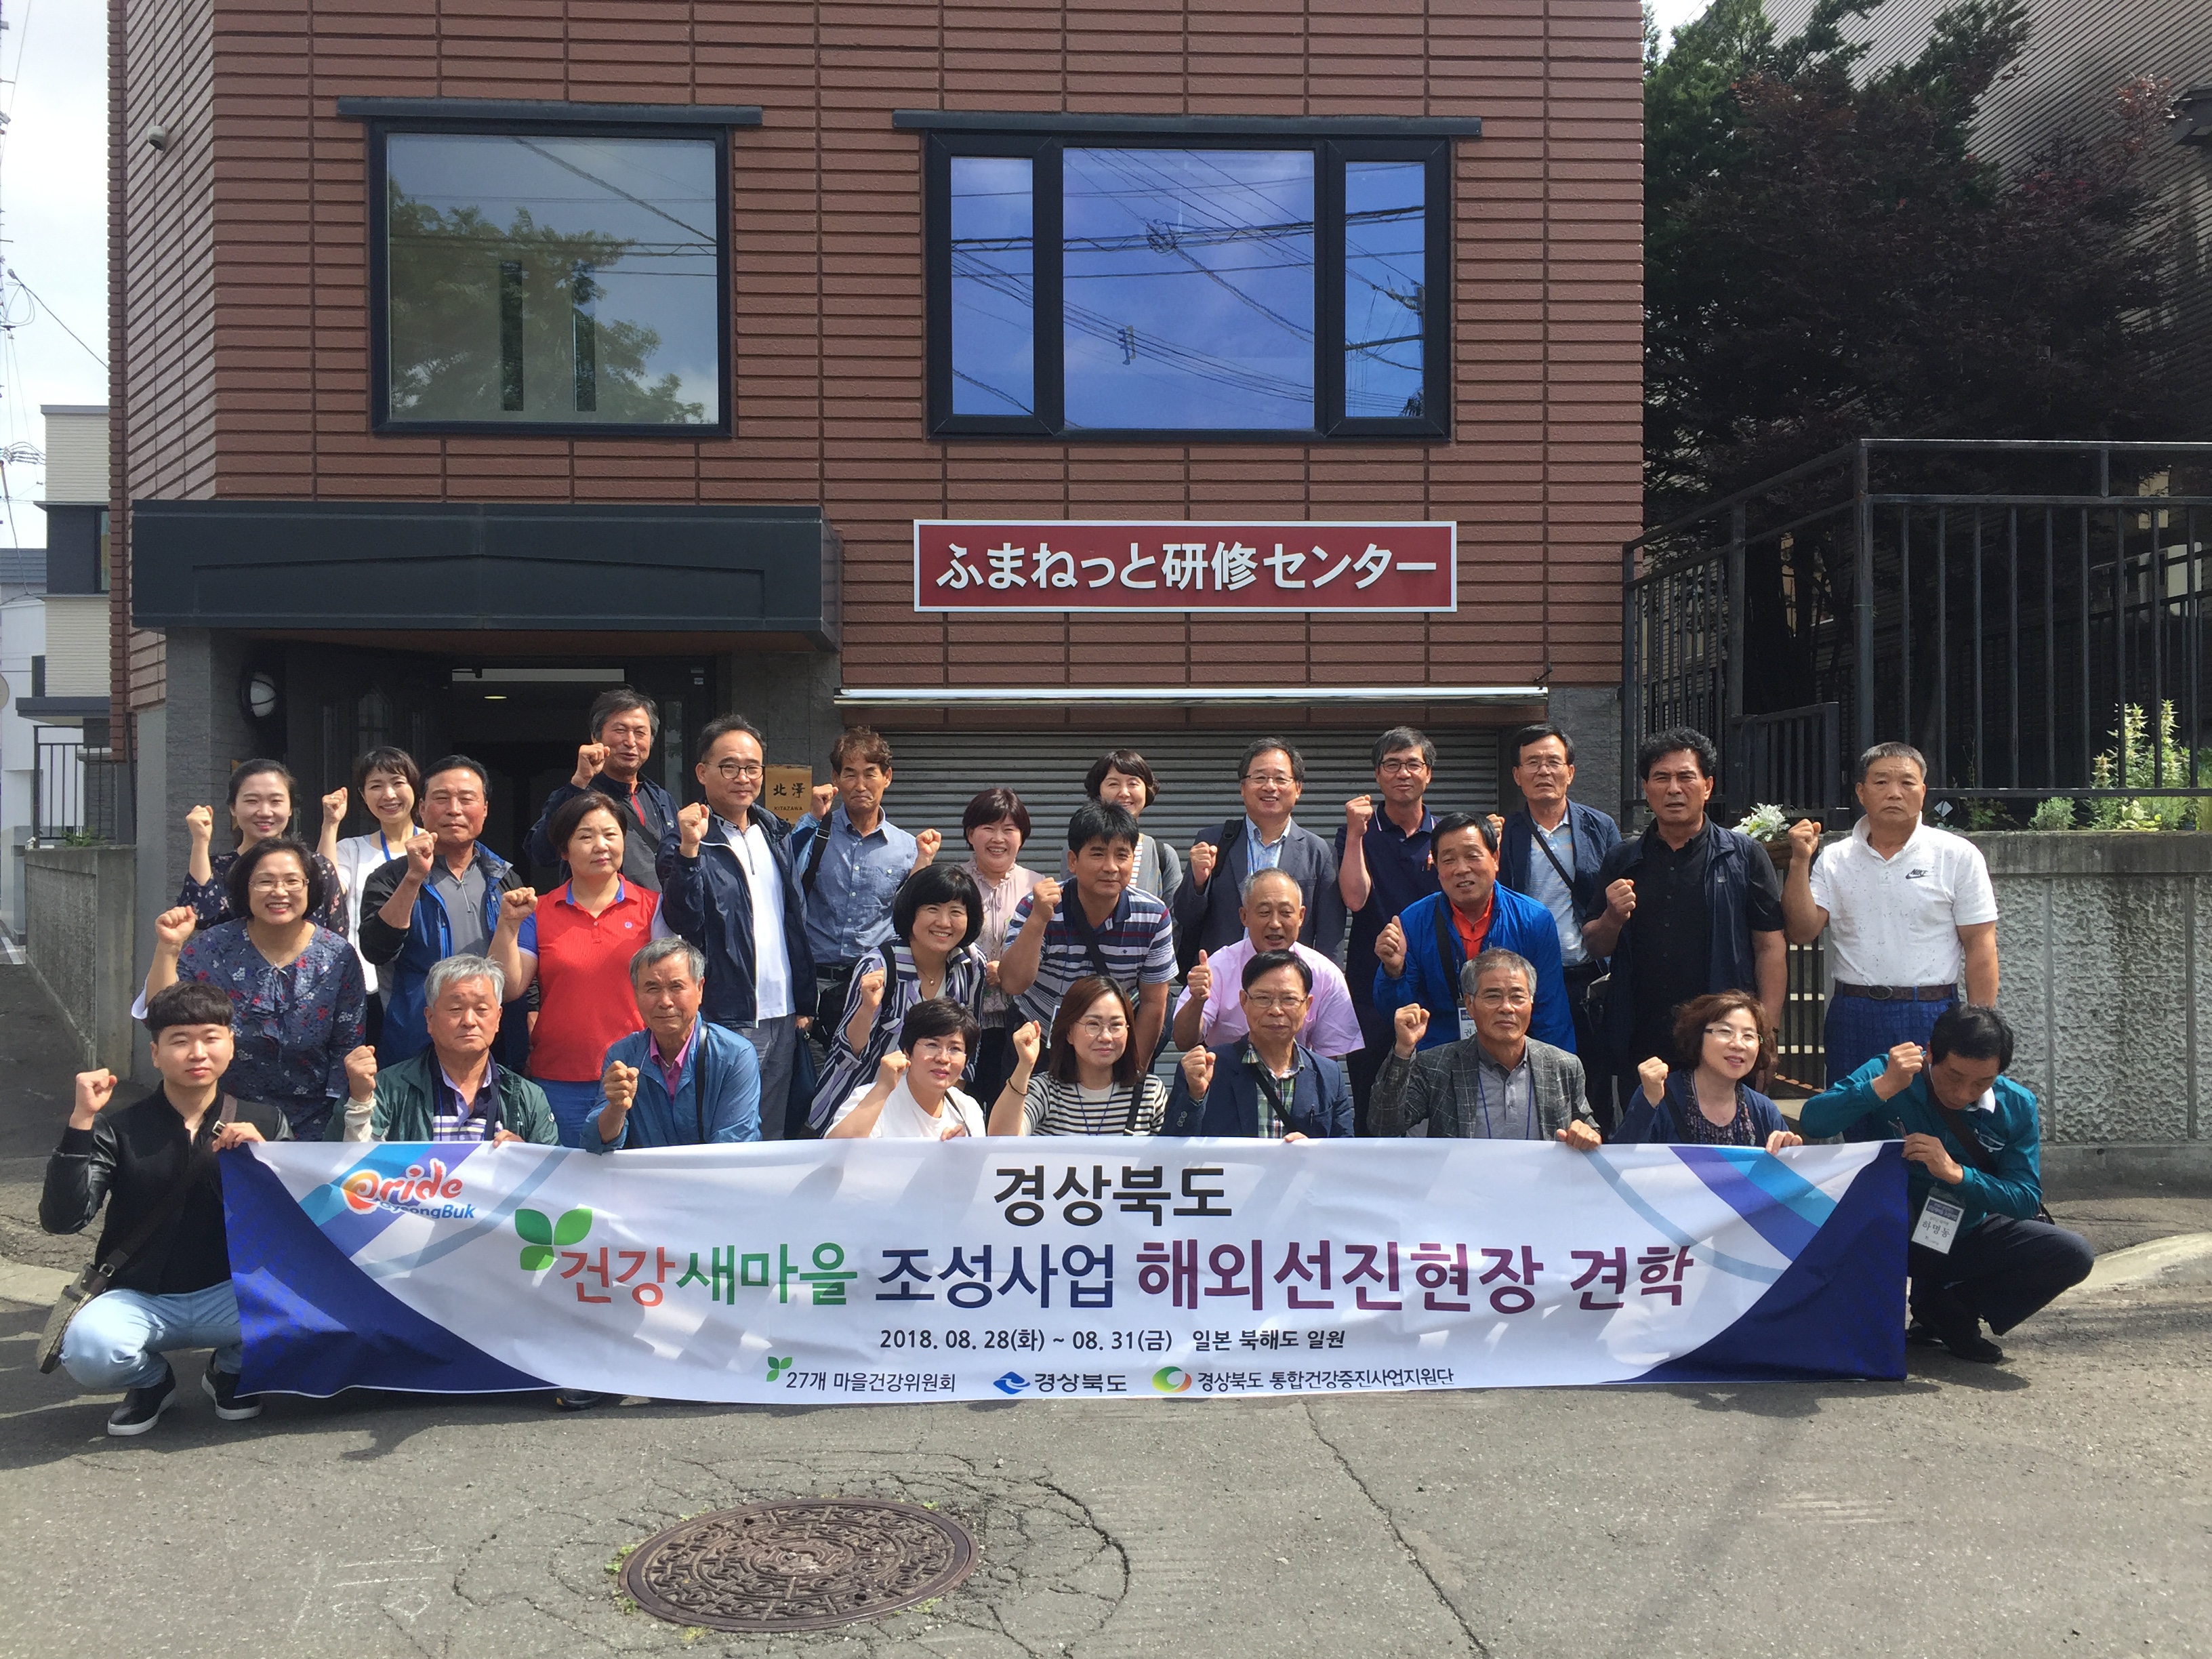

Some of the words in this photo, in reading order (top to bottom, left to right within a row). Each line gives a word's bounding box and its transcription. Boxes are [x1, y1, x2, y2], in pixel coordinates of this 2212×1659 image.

[936, 541, 1437, 591] ふまねっと研修センター
[1911, 869, 1928, 877] NIKE
[994, 1166, 1232, 1226] 경상북도
[560, 1242, 857, 1307] 건강새마을
[875, 1244, 1113, 1309] 조성사업
[1136, 1240, 1544, 1314] 해외선진현장
[1570, 1246, 1694, 1311] 견학
[880, 1330, 938, 1350] 2018.
[945, 1330, 977, 1350] 08.
[984, 1329, 1045, 1352] 28(화)
[1073, 1330, 1104, 1351] 08.
[1111, 1330, 1172, 1352] 31(금)
[1193, 1330, 1233, 1351] 일본
[1239, 1330, 1299, 1351] 북해도
[1307, 1330, 1345, 1349] 일원
[786, 1372, 826, 1391] 27개
[834, 1372, 956, 1393] 마을건강위원회
[1035, 1374, 1127, 1393] 경상북도
[1197, 1372, 1264, 1392] 경상북도
[1269, 1368, 1454, 1390] 통합건강증진사업지원단
